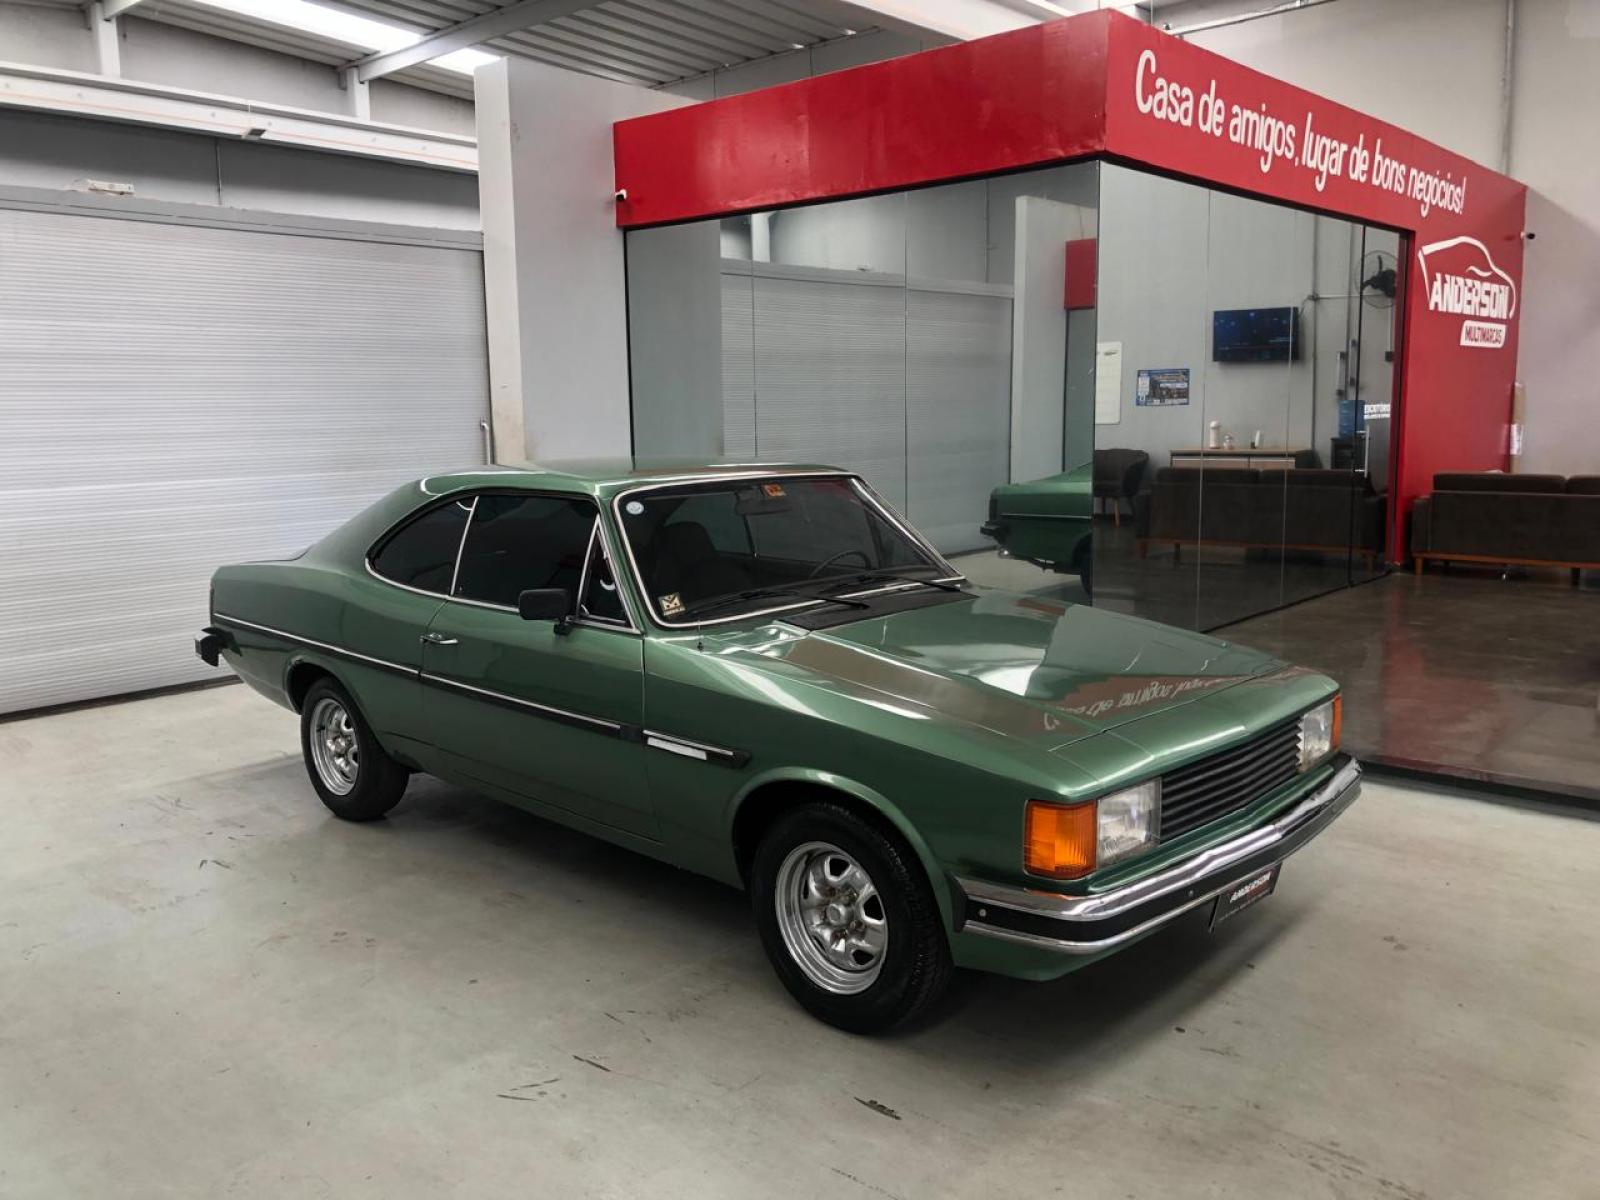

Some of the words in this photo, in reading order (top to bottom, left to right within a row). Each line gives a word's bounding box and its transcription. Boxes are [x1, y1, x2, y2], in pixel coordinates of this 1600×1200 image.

[1136, 49, 1194, 127] Casa
[1198, 79, 1225, 137] de
[1229, 103, 1299, 173] amigos,
[1302, 112, 1348, 192] lugar
[1349, 133, 1369, 183] de
[1372, 138, 1406, 194] bons
[1407, 167, 1467, 218] negócios!
[1429, 272, 1510, 320] ANDERSON
